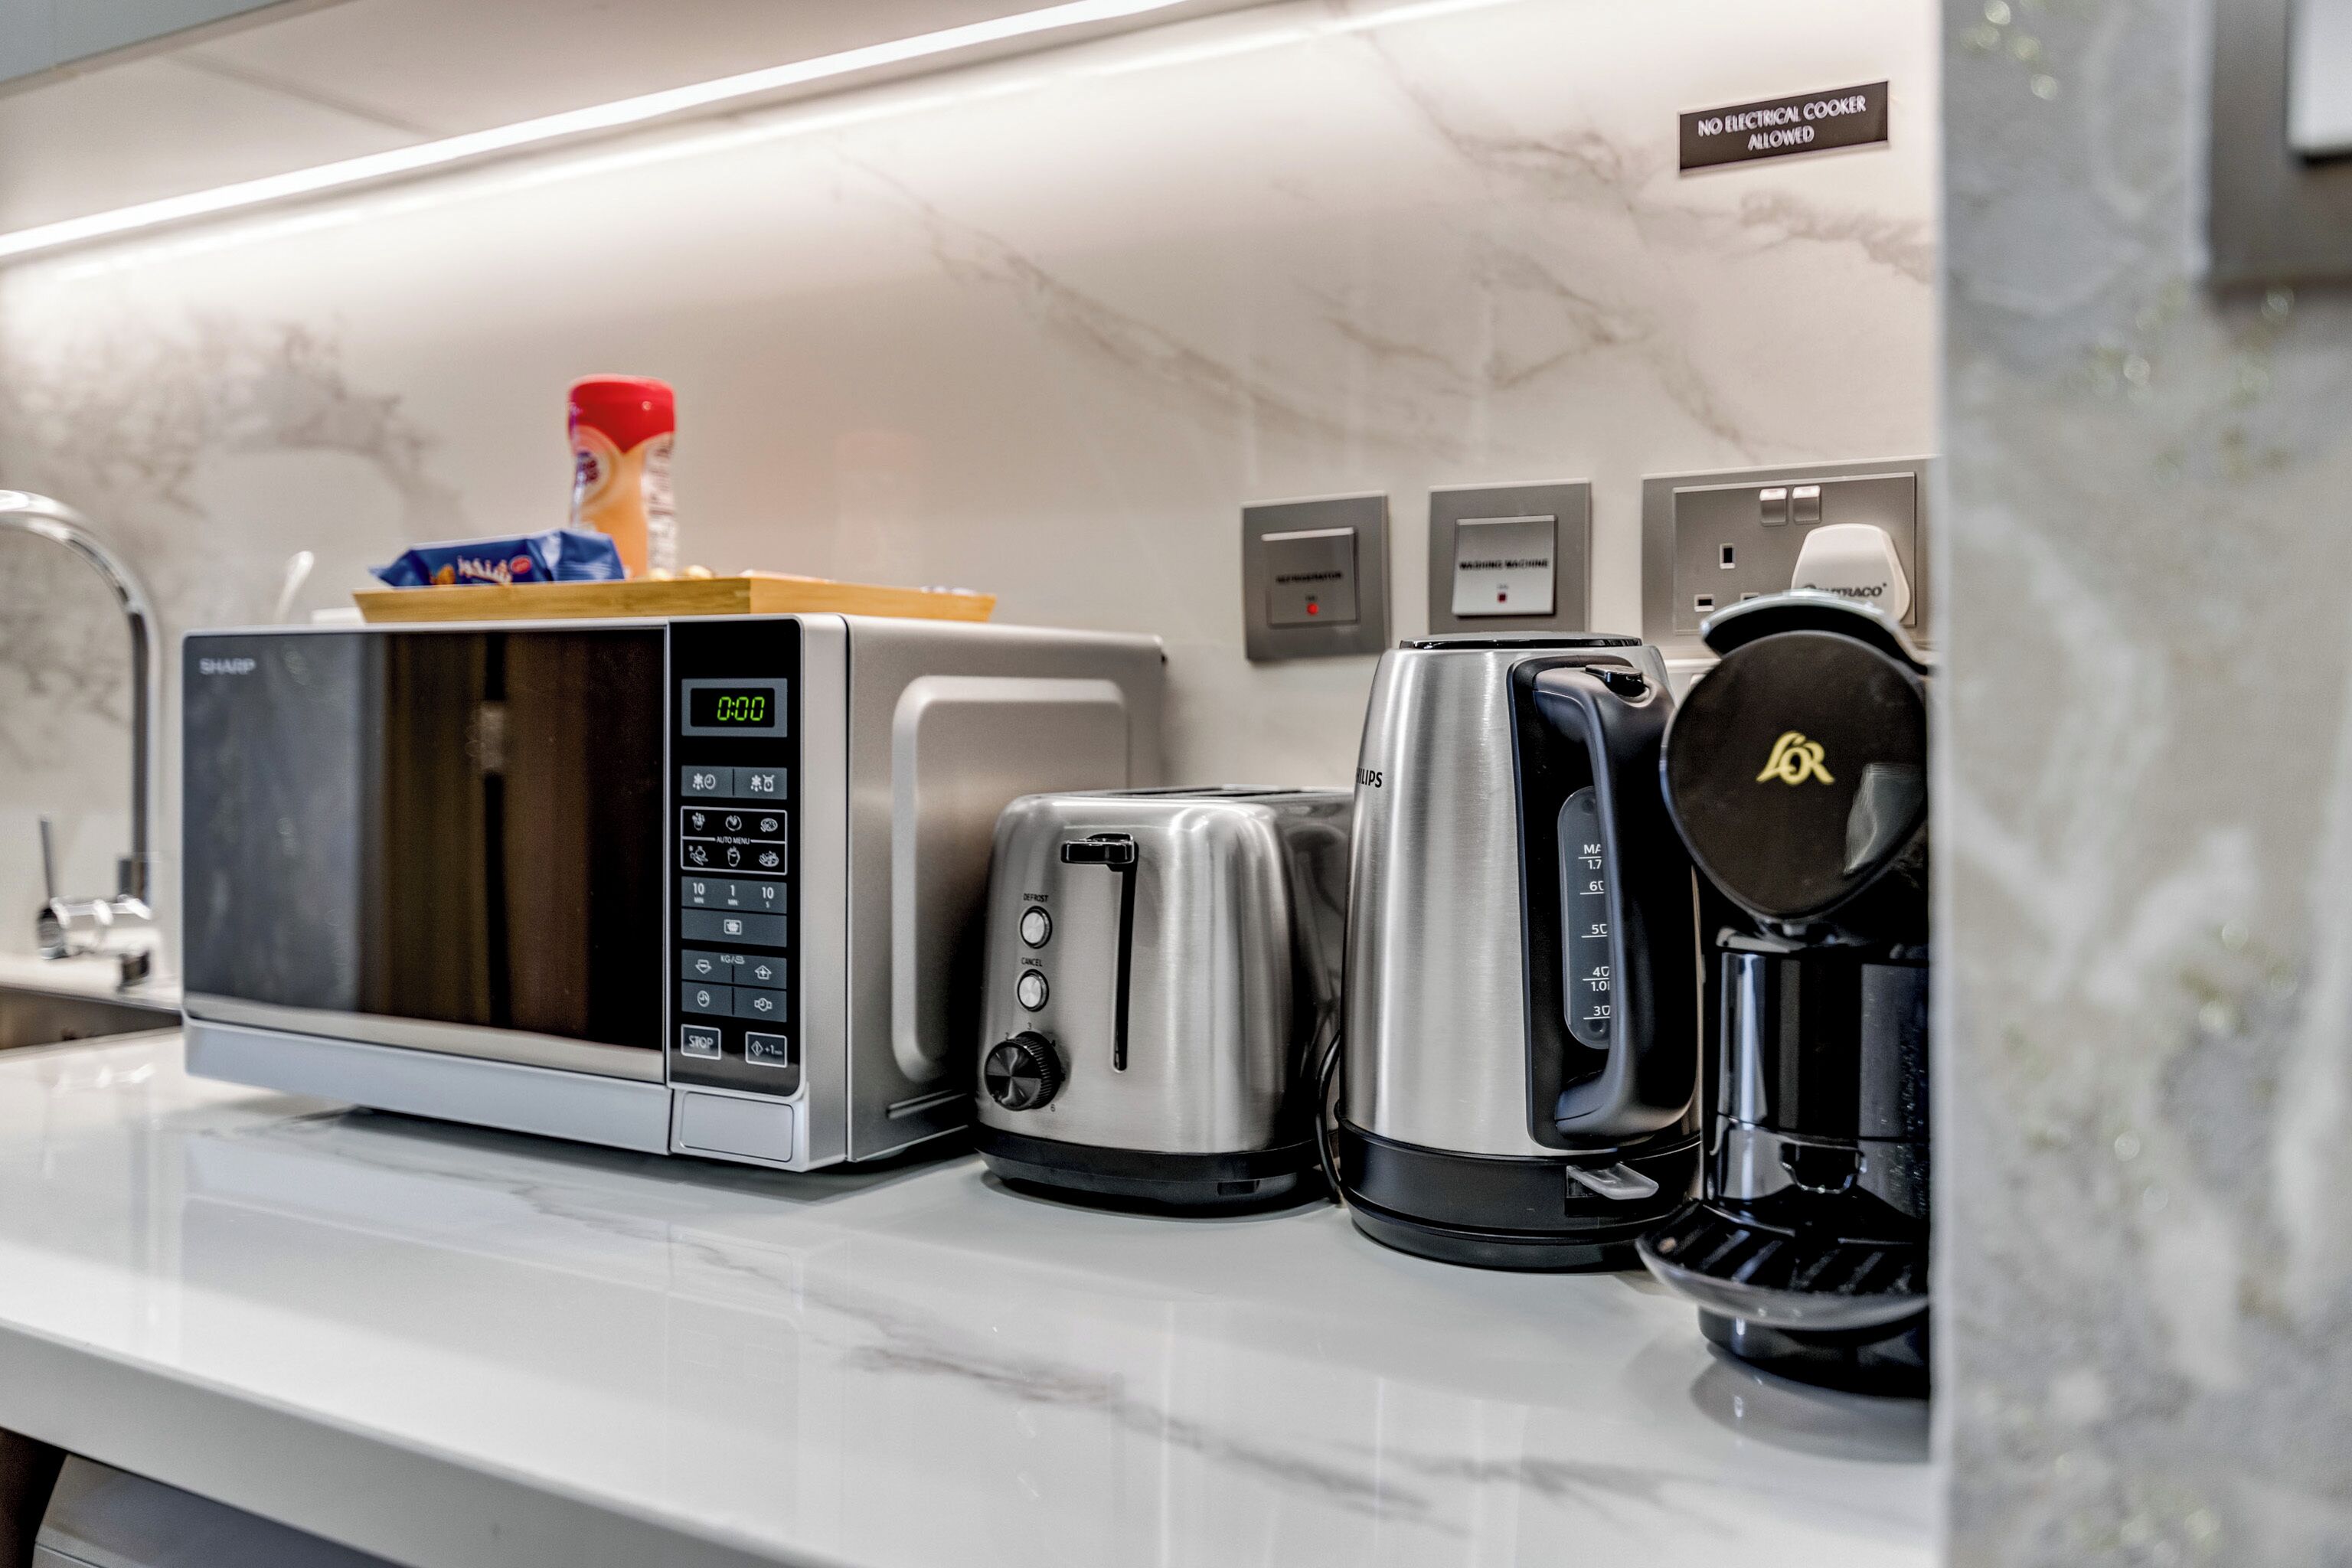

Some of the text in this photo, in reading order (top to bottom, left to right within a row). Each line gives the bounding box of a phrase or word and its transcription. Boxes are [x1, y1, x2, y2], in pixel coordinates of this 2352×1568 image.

[1697, 95, 1867, 137] NO ELECTRICAL COOKER
[1747, 125, 1815, 152] ALLOWED
[1459, 558, 1548, 570] WASHING MACHINE
[200, 658, 256, 675] SHARP
[717, 696, 765, 721] 0:00
[717, 835, 750, 845] AUTO MENU
[1583, 844, 1602, 854] MA
[1587, 859, 1602, 870] 1.7
[693, 882, 705, 895] 10
[730, 884, 735, 897] 1
[762, 886, 774, 900] 10
[1023, 893, 1048, 902] DEFROST
[1021, 957, 1043, 967] CANCEL
[688, 1034, 714, 1050] STOP
